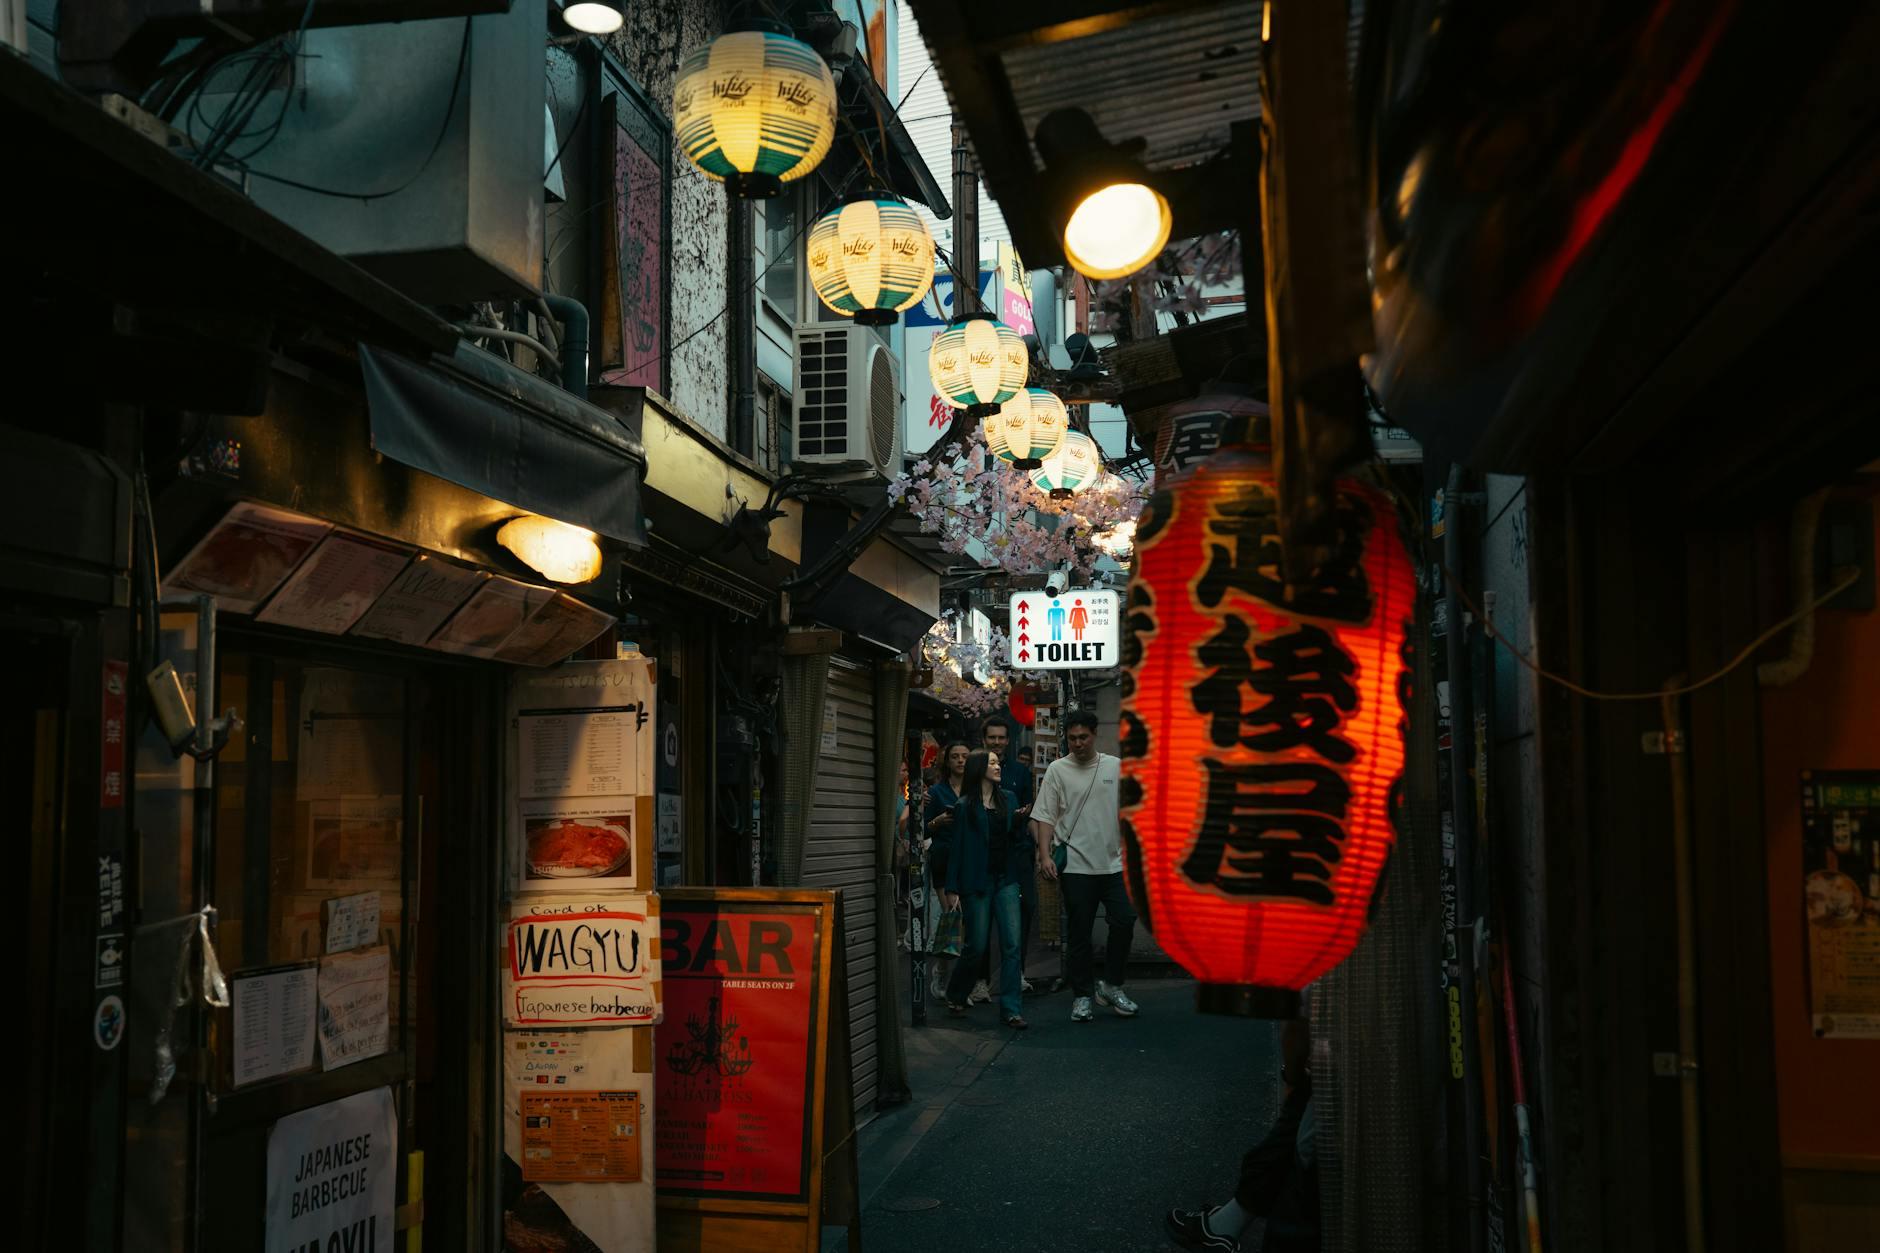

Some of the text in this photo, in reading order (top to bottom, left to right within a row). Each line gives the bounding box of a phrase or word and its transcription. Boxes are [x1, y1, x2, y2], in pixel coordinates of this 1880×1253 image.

[1035, 642, 1105, 662] TOILET
[516, 924, 639, 976] WAGYU
[661, 920, 794, 974] BAR
[518, 995, 587, 1018] Japanese
[721, 981, 795, 989] TABLE SEATS ON 2F
[295, 1133, 371, 1183] JAPANESE
[291, 1167, 367, 1220] BARBECUE
